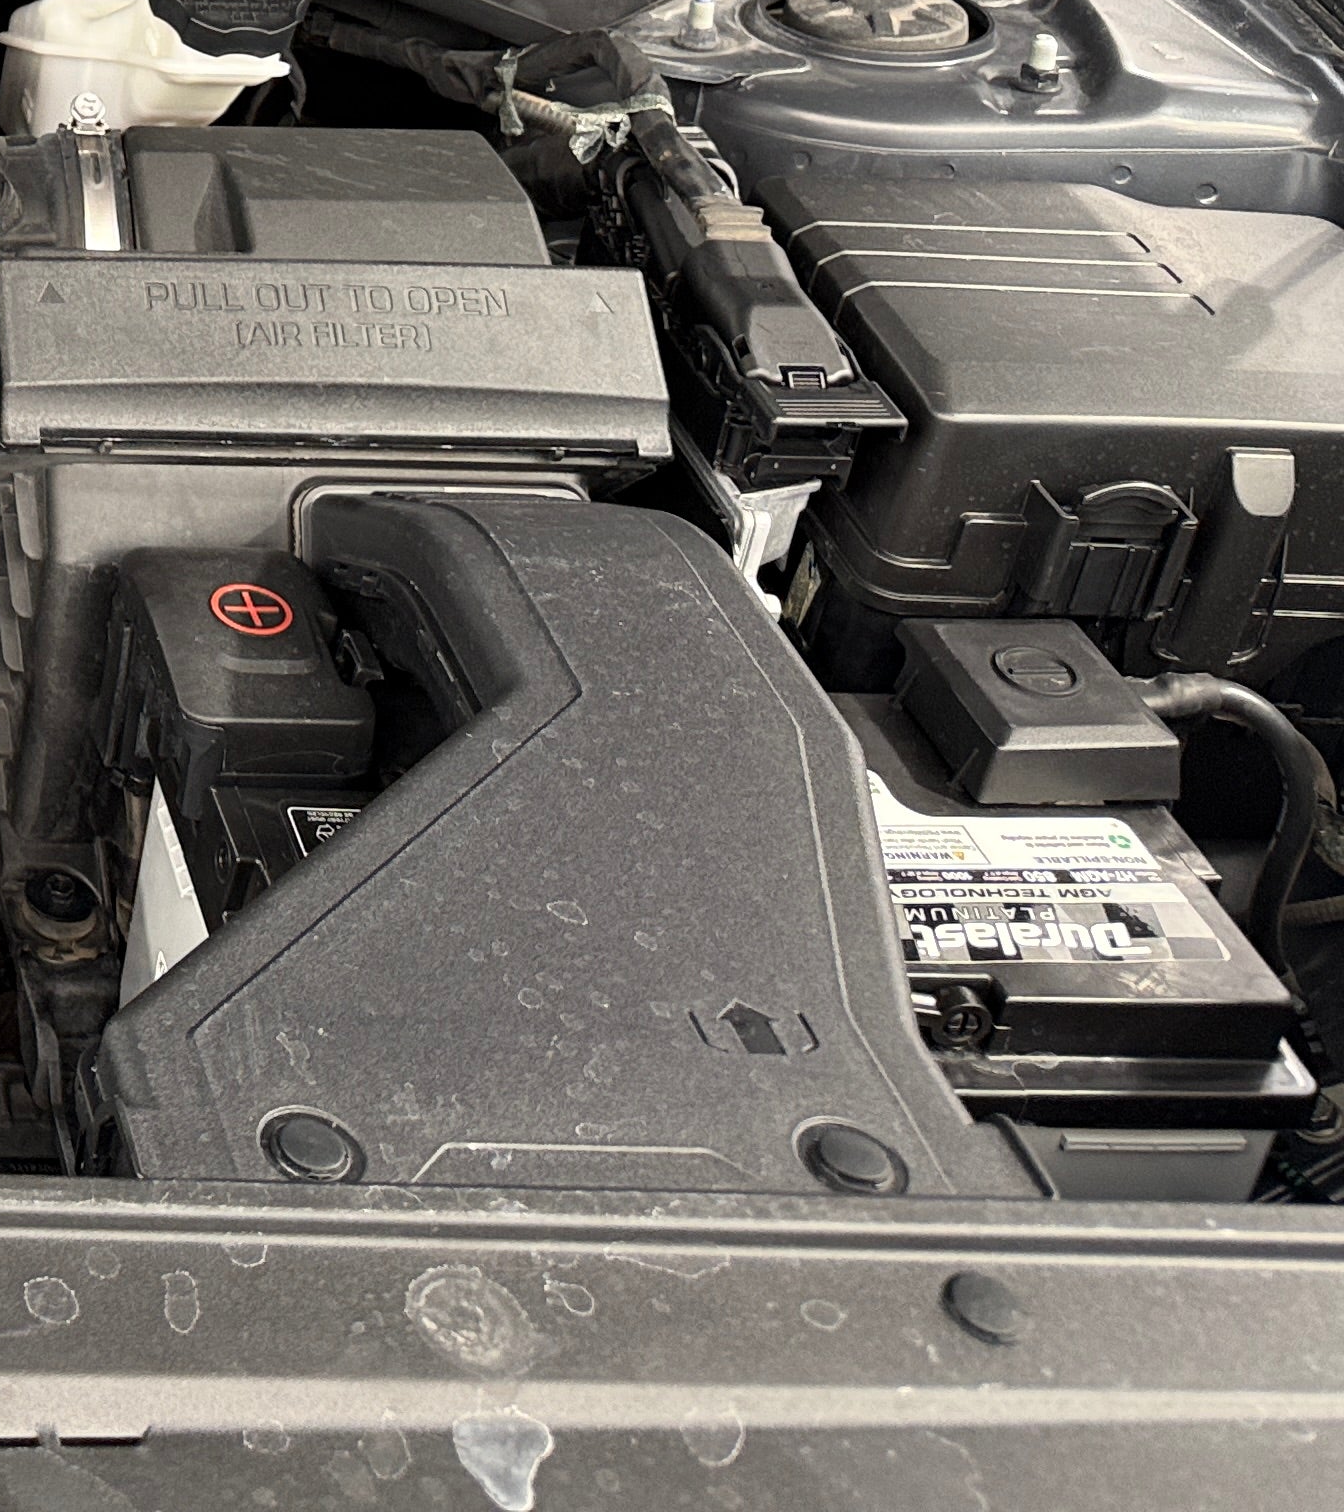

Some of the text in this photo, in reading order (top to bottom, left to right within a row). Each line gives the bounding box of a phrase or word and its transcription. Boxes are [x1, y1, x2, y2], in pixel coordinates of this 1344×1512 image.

[143, 280, 512, 318] PULL OUT TO OPEN
[1056, 888, 1112, 899] AGM
[904, 906, 1054, 922] PLATINUM
[910, 921, 1152, 958] Duralast
